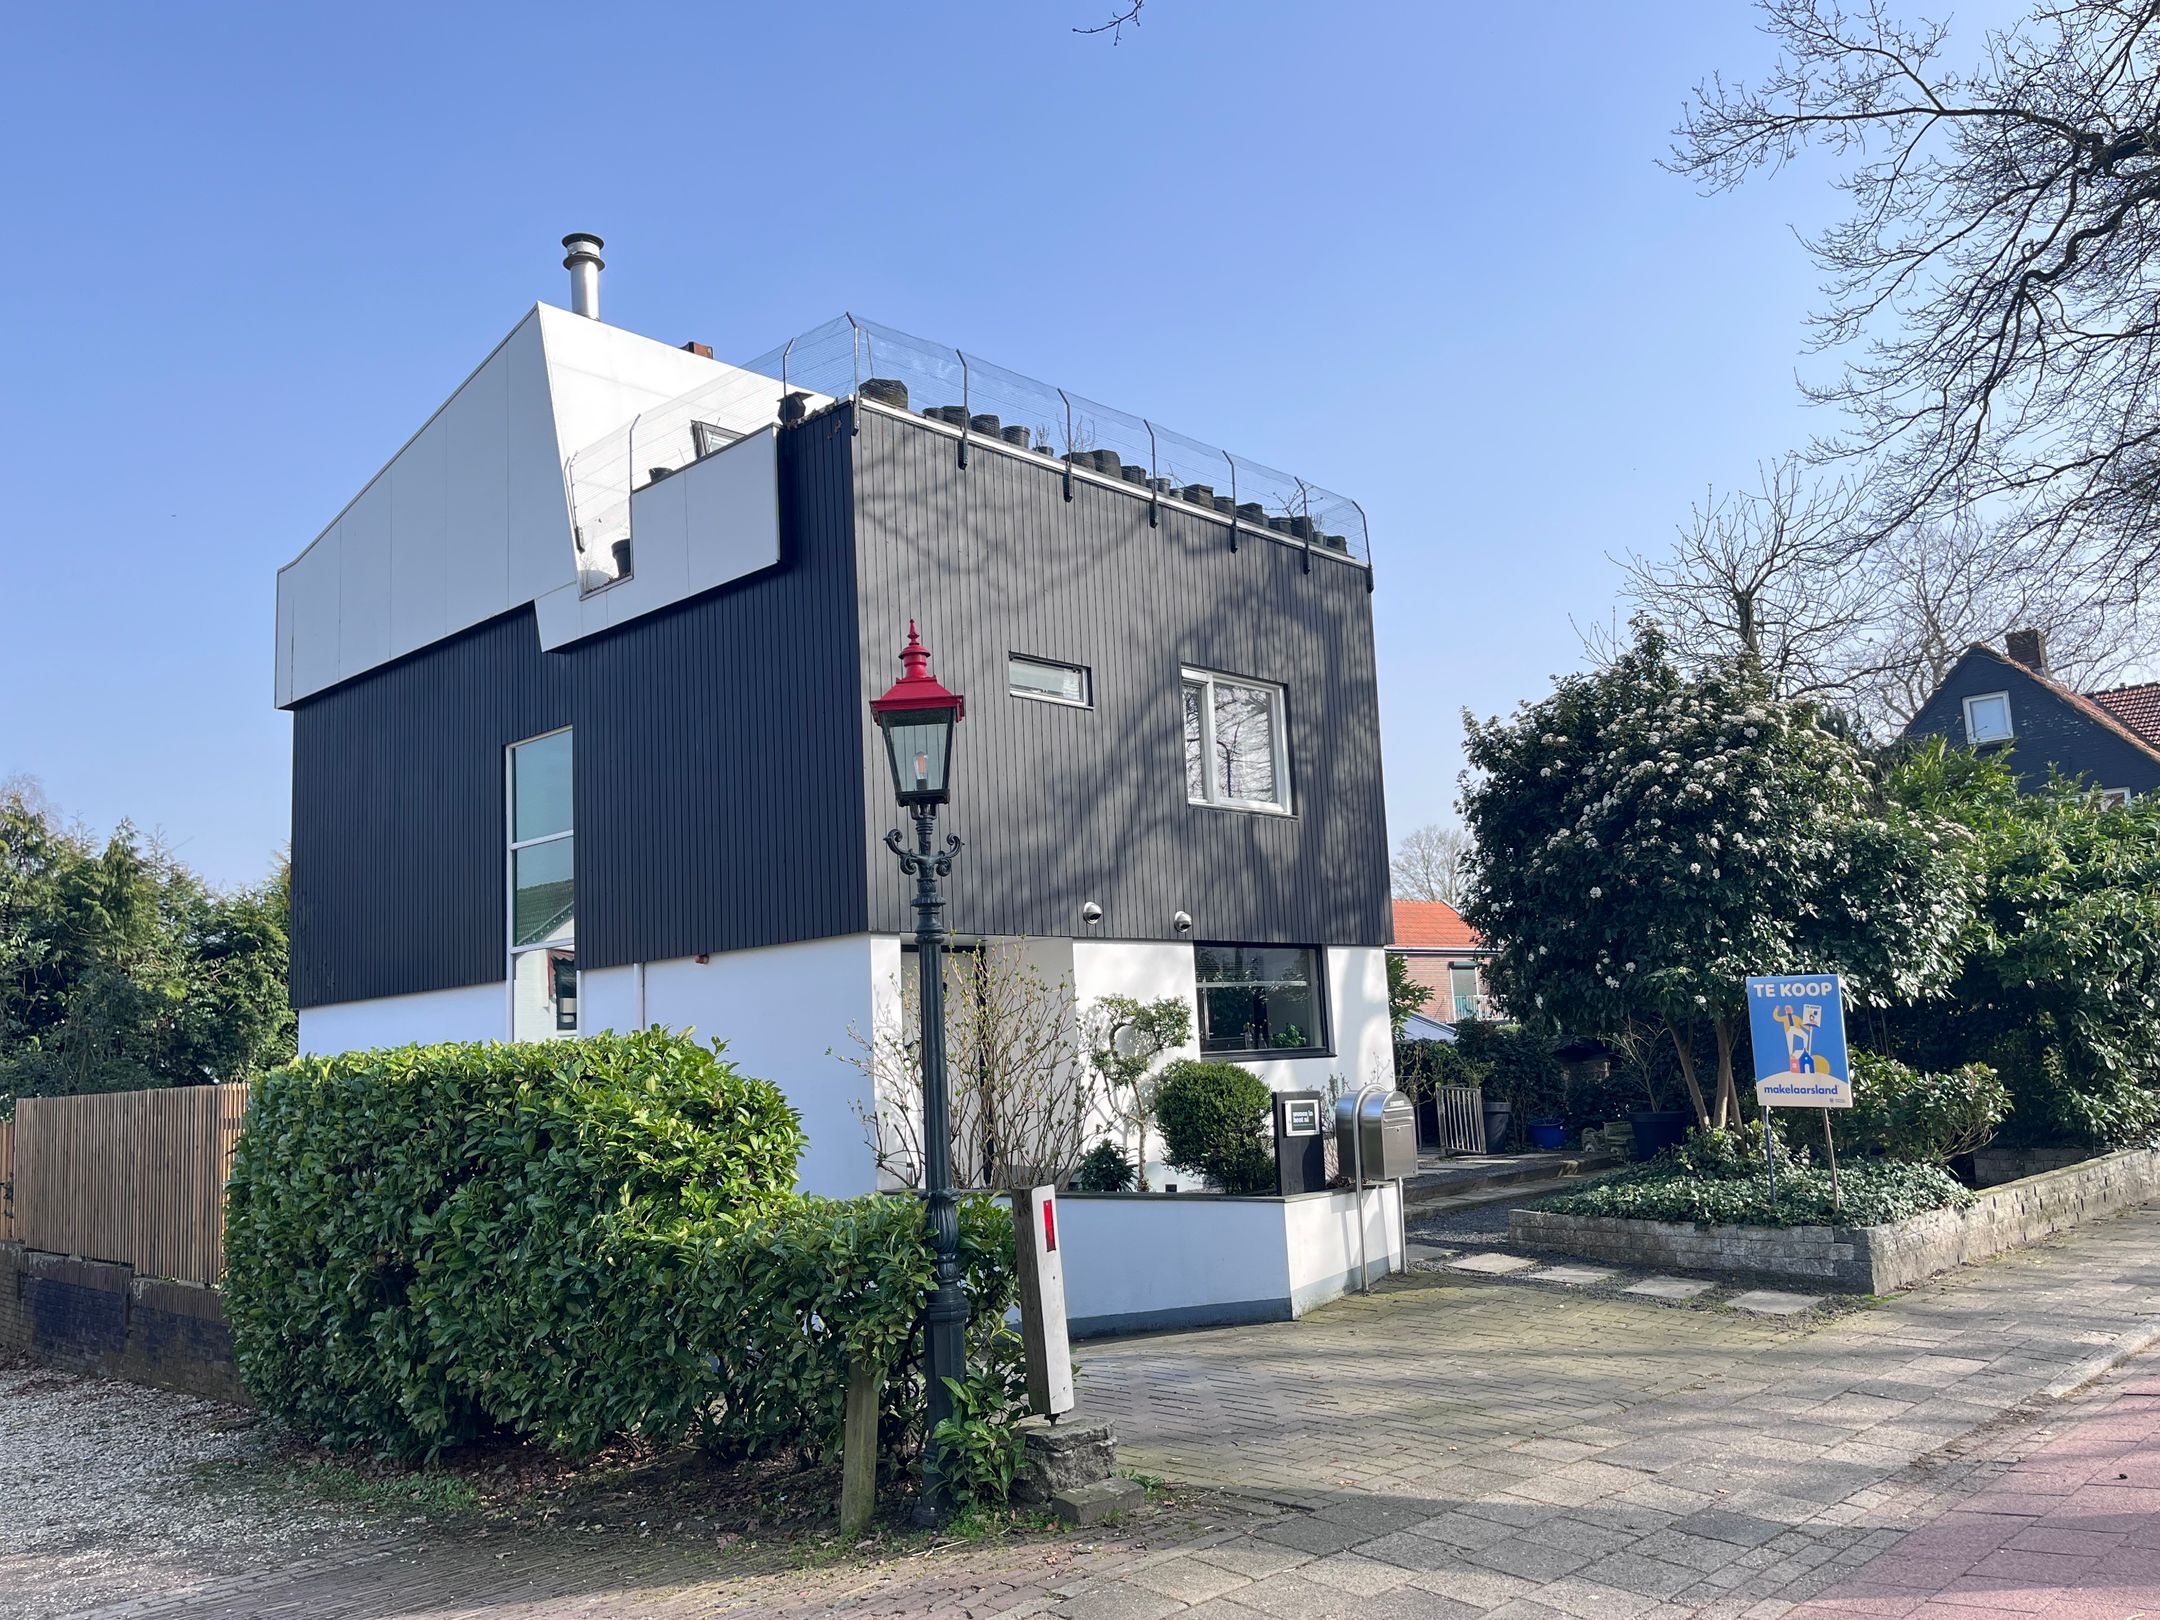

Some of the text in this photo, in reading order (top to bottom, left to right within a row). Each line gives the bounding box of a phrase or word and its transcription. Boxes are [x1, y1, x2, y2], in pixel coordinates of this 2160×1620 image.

[1753, 982, 1833, 998] TE KOOP
[1764, 1084, 1838, 1095] makelaarsland
